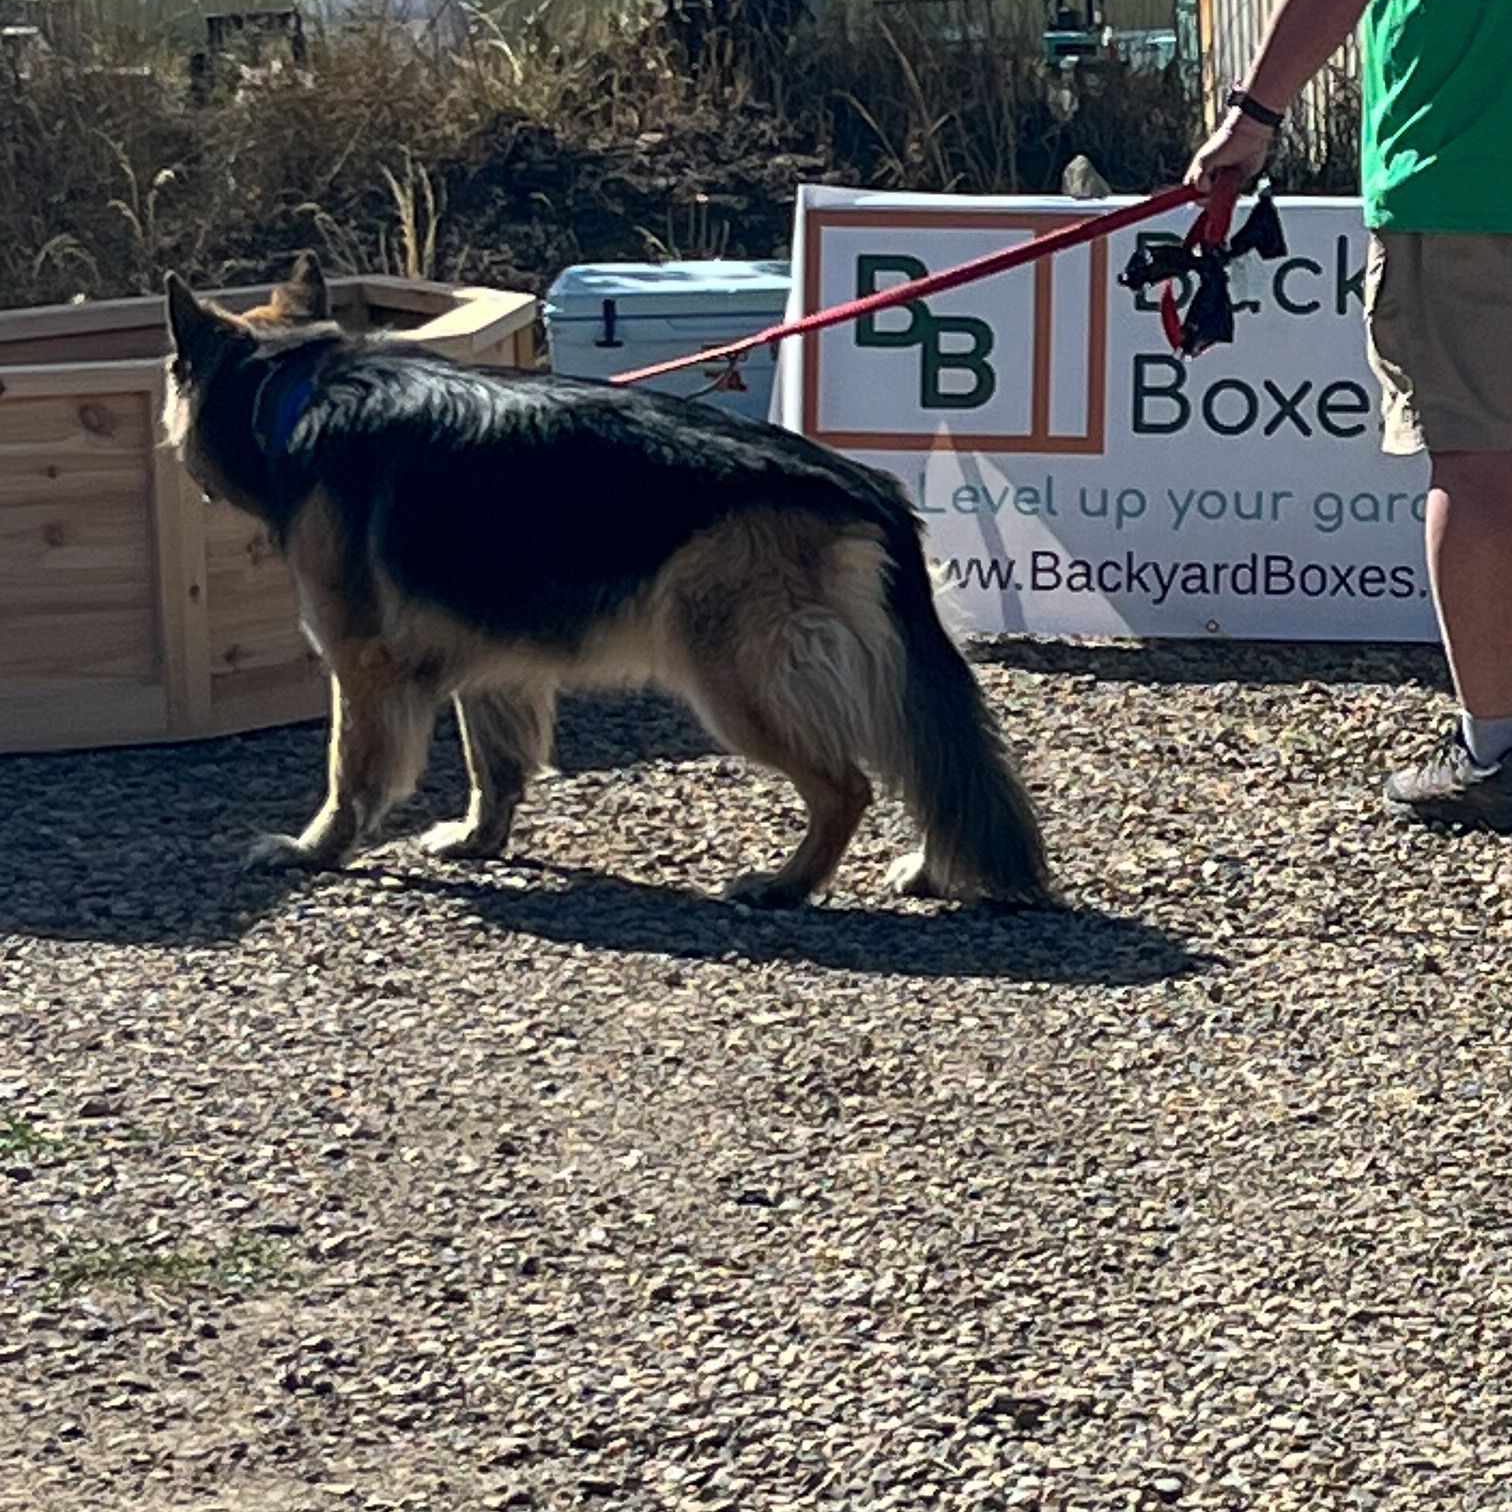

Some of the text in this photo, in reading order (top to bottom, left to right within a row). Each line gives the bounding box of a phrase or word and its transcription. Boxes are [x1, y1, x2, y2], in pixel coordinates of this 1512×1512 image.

[918, 471, 1056, 516] Level
[1079, 487, 1147, 531] up
[1168, 488, 1293, 530] your
